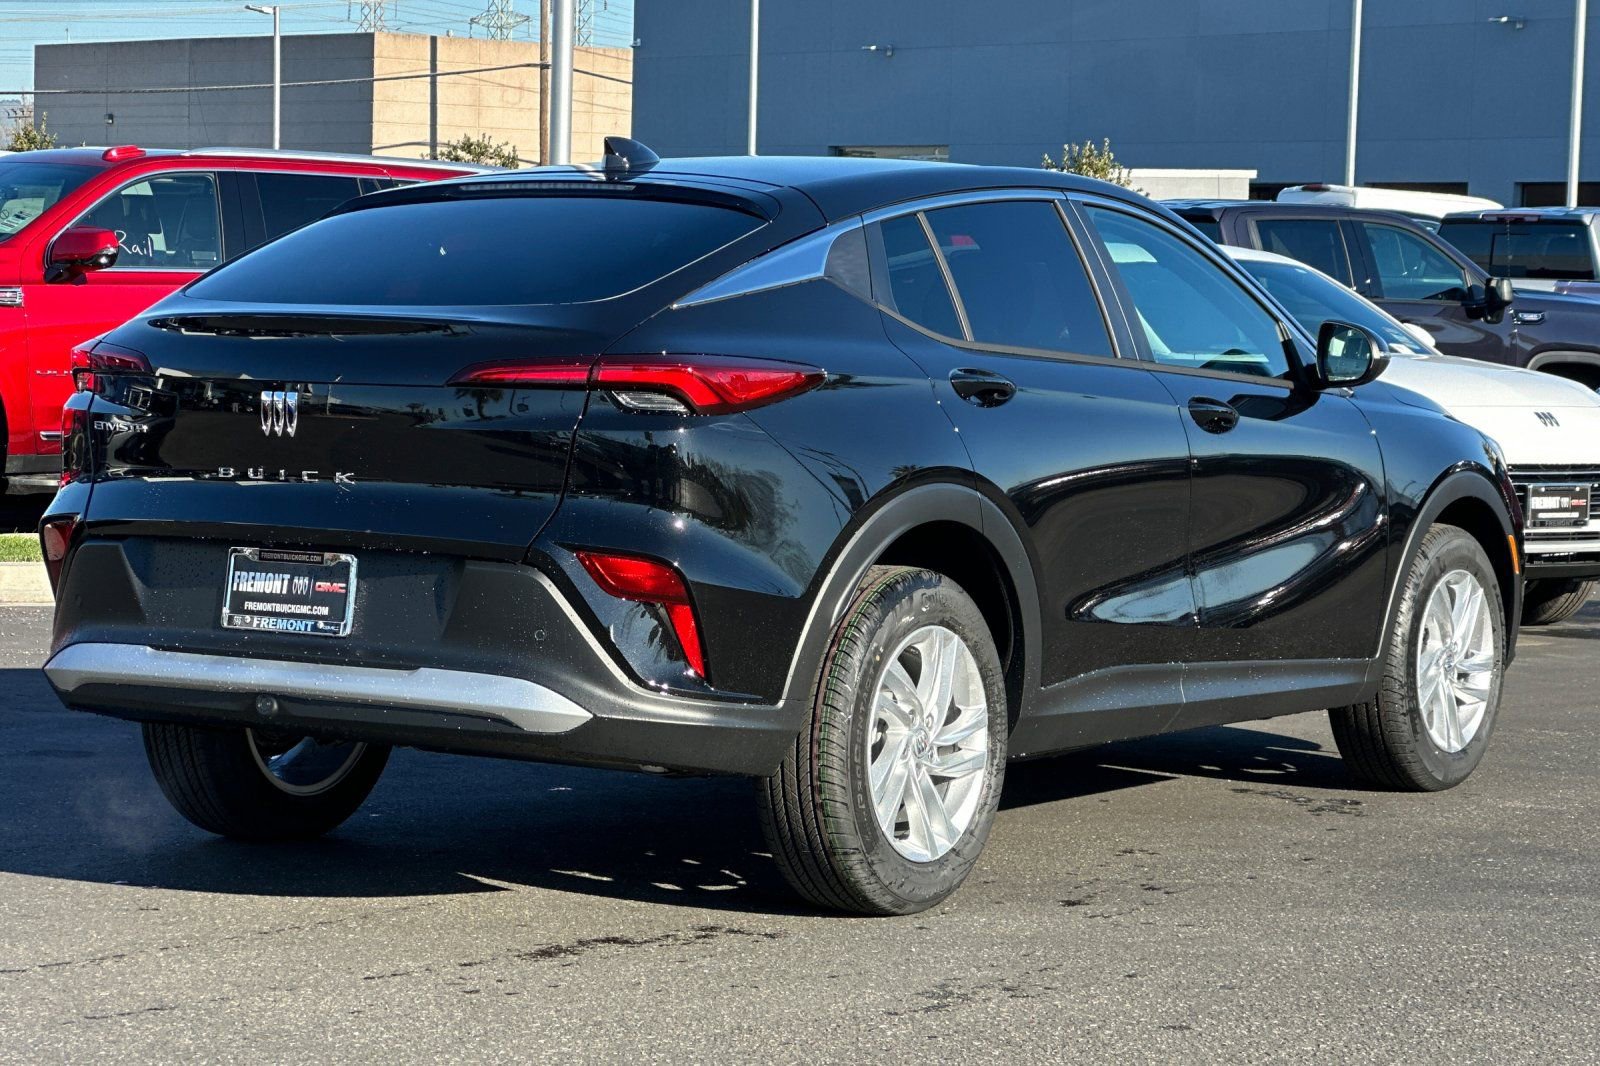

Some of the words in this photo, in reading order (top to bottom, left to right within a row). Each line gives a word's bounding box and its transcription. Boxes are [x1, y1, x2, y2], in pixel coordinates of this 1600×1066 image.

[114, 229, 153, 258] Rail
[218, 466, 356, 485] BUICK
[261, 551, 322, 562] FREMONTBUICKGMC.COM
[232, 570, 290, 594] FREMONT
[314, 581, 346, 594] GMC
[244, 601, 329, 616] FREMONTBUICKGMC.COM
[252, 617, 314, 632] FREMONT
